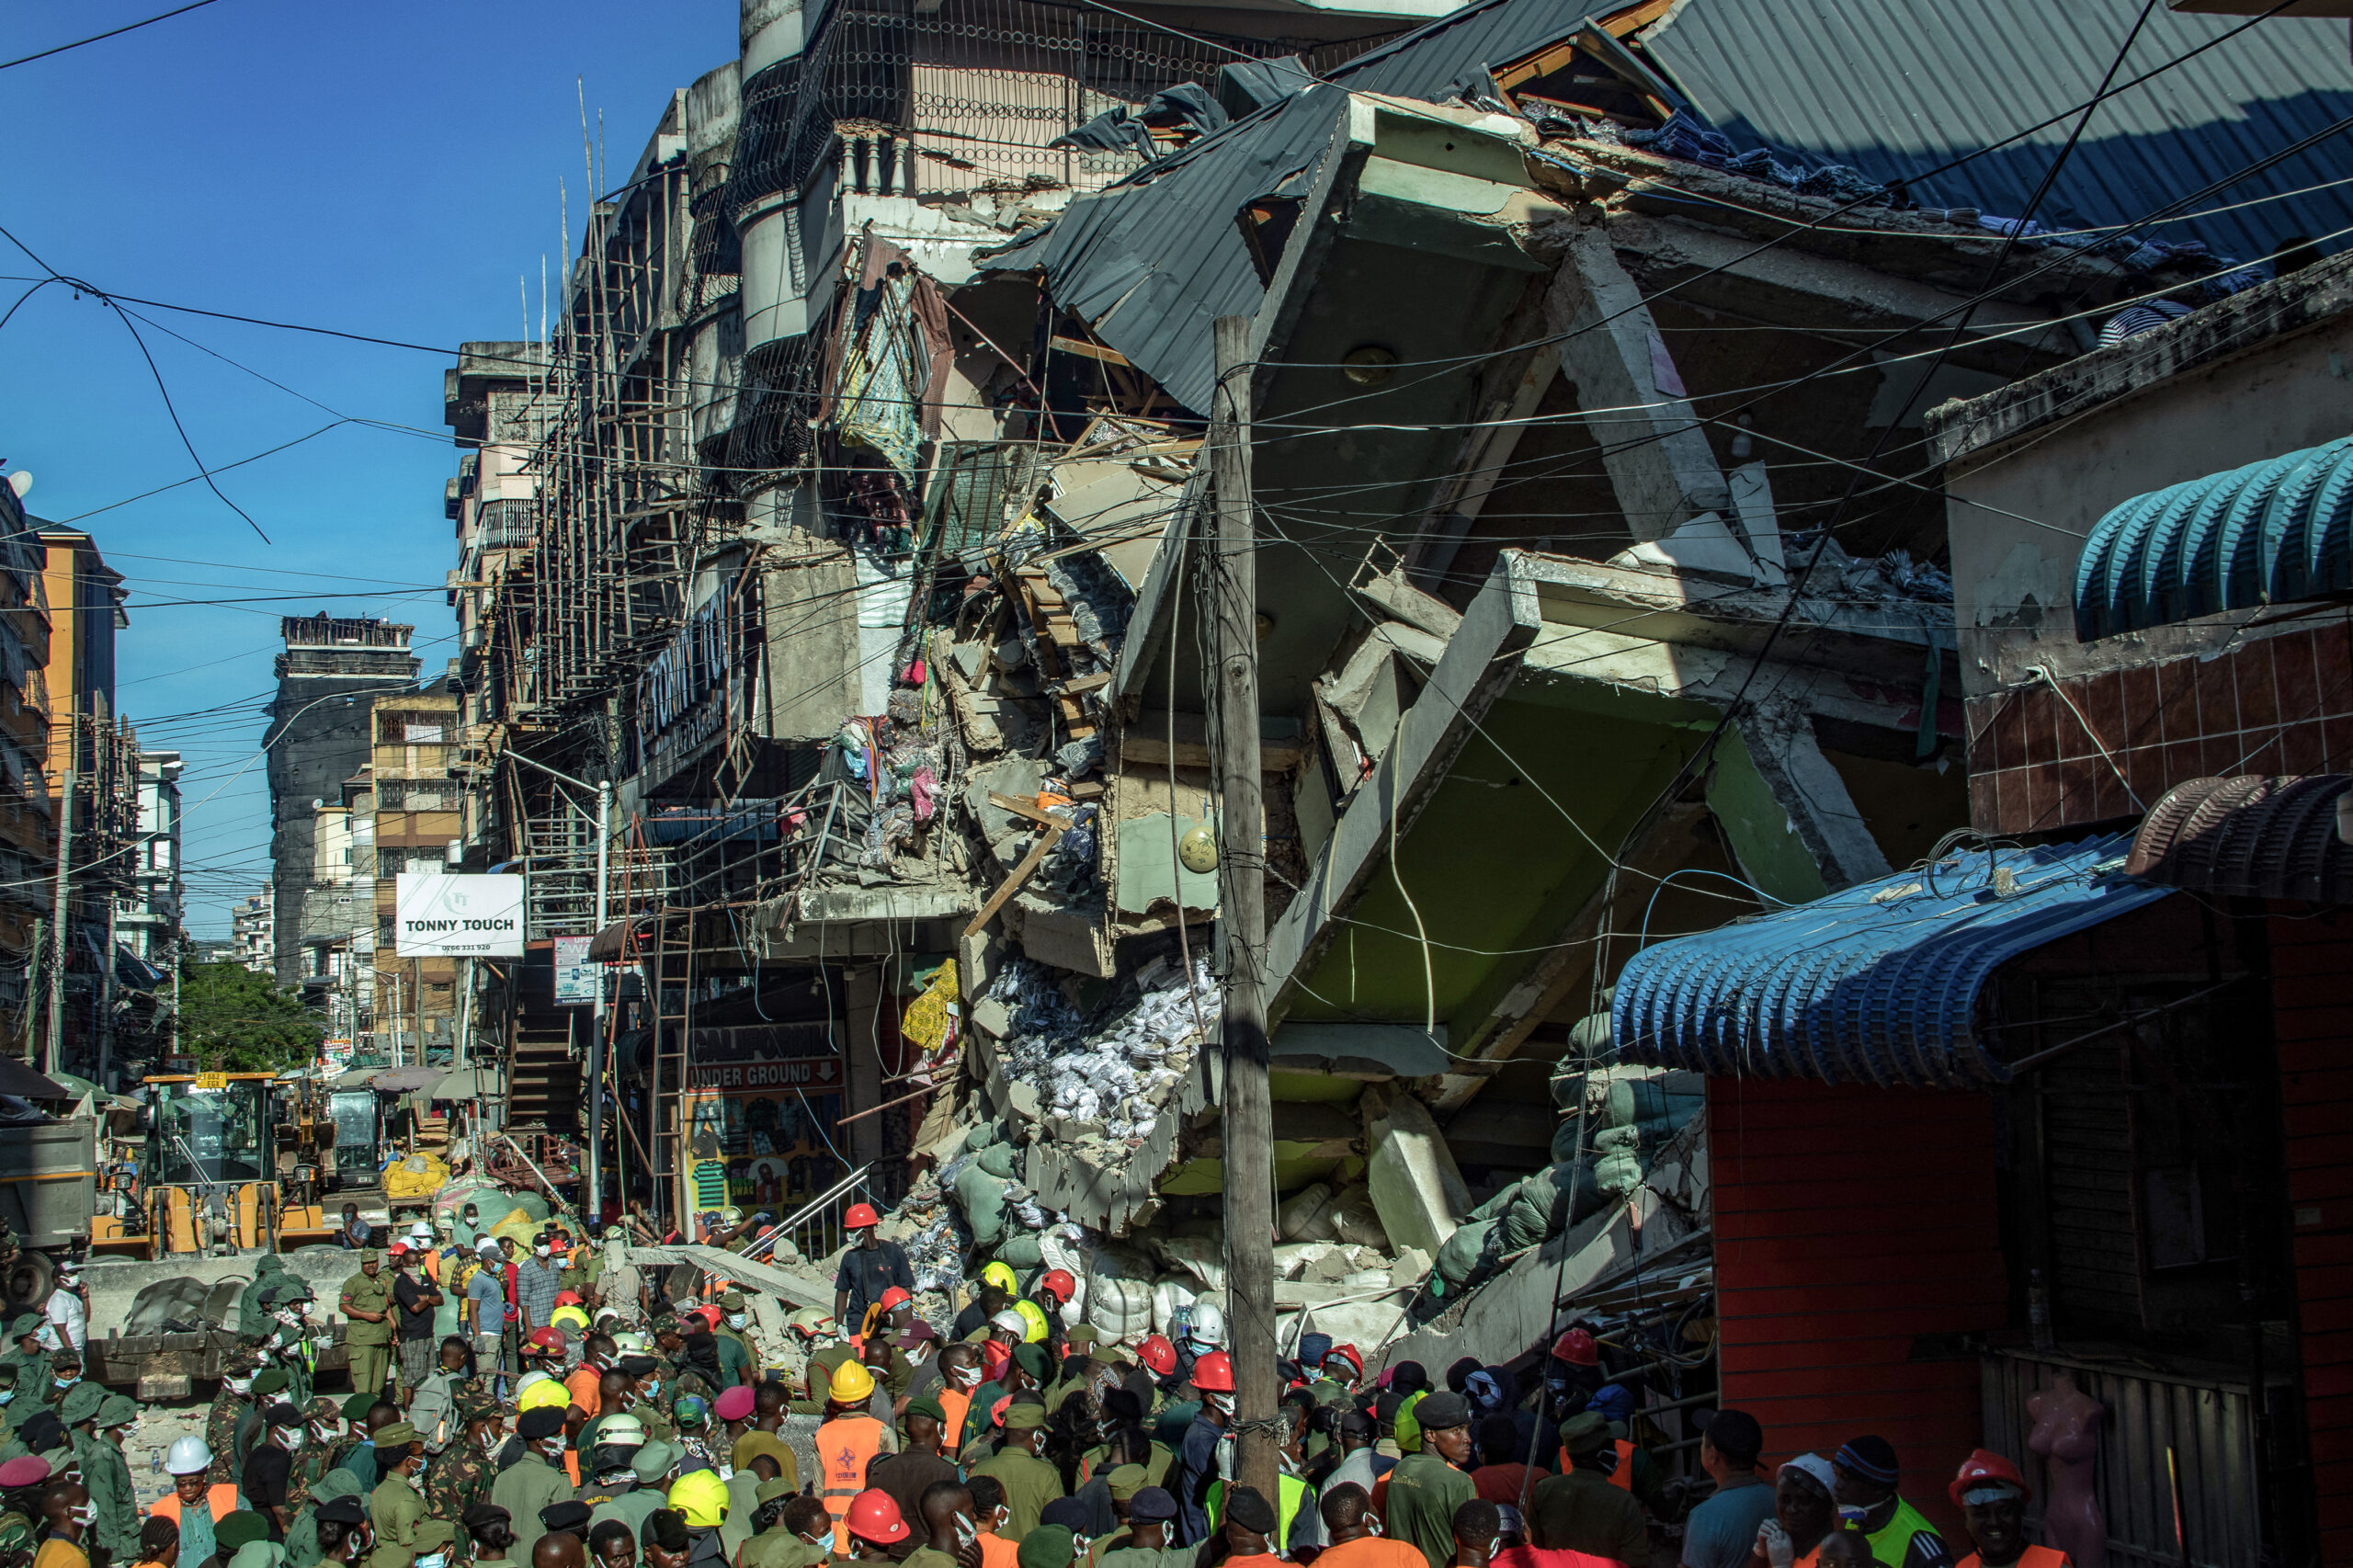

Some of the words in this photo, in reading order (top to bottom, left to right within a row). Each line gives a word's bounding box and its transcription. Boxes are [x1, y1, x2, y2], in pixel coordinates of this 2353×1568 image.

[405, 920, 458, 932] TONNY
[462, 919, 514, 931] TOUCH
[688, 1024, 838, 1063] CALIFORNIA
[690, 1067, 743, 1089] UNDER
[746, 1063, 811, 1085] GROUND
[732, 1187, 754, 1197] SWAG
